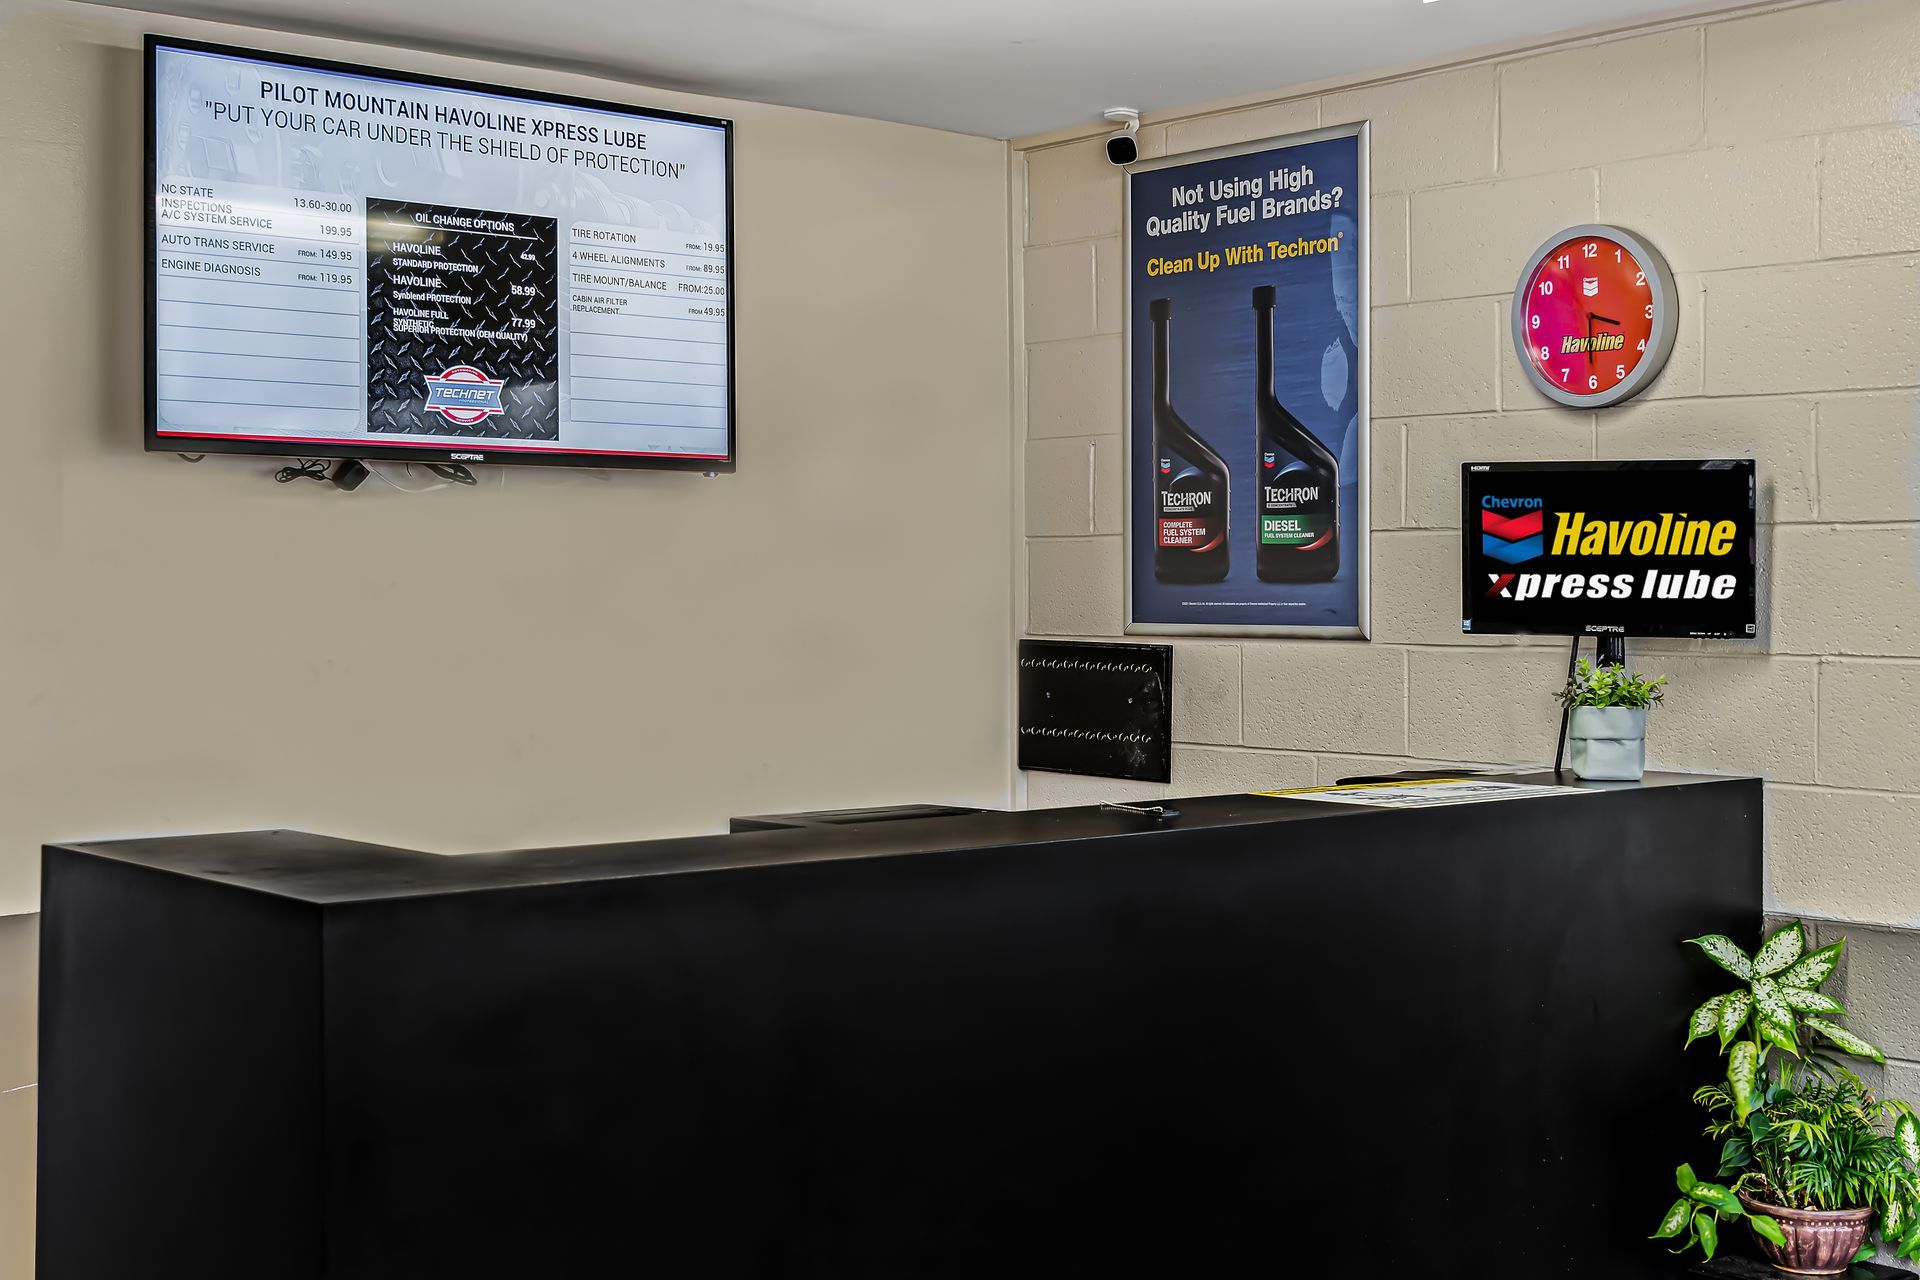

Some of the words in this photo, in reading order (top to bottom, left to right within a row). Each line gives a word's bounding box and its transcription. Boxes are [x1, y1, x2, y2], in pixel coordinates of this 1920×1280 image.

[260, 80, 319, 106] PILOT
[325, 90, 429, 121] MOUNTAIN
[435, 105, 527, 133] HAVOLINE
[531, 119, 599, 143] XPRESS
[604, 129, 647, 150] LUBE
[205, 101, 255, 124] "PUT
[261, 108, 316, 132] YOUR
[322, 117, 361, 139] CAR
[367, 123, 432, 147] UNDER
[437, 132, 473, 152] THE
[479, 137, 541, 161] SHIELD
[547, 146, 569, 164] OF
[574, 150, 686, 179] PROTECTION"
[161, 184, 177, 194] NC
[179, 185, 214, 198] STATE
[1172, 184, 1204, 207] Not
[1209, 176, 1263, 201] Using
[1269, 165, 1314, 193] High
[161, 198, 233, 214] INSPECTIONS
[294, 198, 352, 213] 13.60-30.00
[1146, 209, 1210, 237] Quality
[1216, 200, 1255, 226] Fuel
[1262, 186, 1343, 219] Brands?
[161, 209, 181, 220] A/C
[183, 211, 227, 224] SYSTEM
[230, 216, 272, 229] SERVICE
[415, 213, 431, 224] OIL
[433, 214, 472, 228] CHANGE
[473, 218, 515, 232] OPTIONS
[319, 225, 352, 237] 199.95
[572, 228, 591, 239] TIRE
[593, 231, 636, 244] ROTATION
[161, 234, 191, 246] AUTO
[194, 236, 230, 249] TRANS
[232, 240, 275, 254] SERVICE
[392, 242, 441, 256] HAVOLINE
[685, 243, 701, 251] FROM:
[703, 242, 725, 253] 19.95
[1582, 243, 1598, 258] 12
[298, 250, 317, 258] FROM:
[319, 249, 352, 261] 149.95
[572, 251, 578, 260] 4
[579, 252, 609, 263] WHEEL
[610, 256, 666, 269] ALIGNMENTS
[1146, 257, 1193, 277] Clean
[1197, 251, 1220, 273] Up
[1225, 244, 1264, 266] With
[1557, 255, 1570, 269] 11
[1614, 249, 1621, 263] 1
[161, 258, 202, 272] ENGINE
[204, 262, 261, 276] DIAGNOSIS
[392, 258, 433, 269] STANDARD
[433, 261, 479, 273] PROTECTION
[703, 264, 725, 274] 89.95
[298, 273, 317, 282] FROM:
[319, 273, 352, 285] 119.95
[392, 275, 442, 288] HAVOLINE
[572, 273, 591, 283] TIRE
[593, 275, 667, 291] MOUNT/BALANCE
[1635, 271, 1645, 286] 2
[511, 285, 536, 296] 58.99
[1538, 281, 1553, 295] 10
[392, 291, 425, 302] Synblend
[426, 293, 472, 305] PROTECTION
[572, 295, 593, 303] CABIN
[593, 296, 605, 304] AIR
[606, 297, 628, 306] FILTER
[393, 307, 430, 318] HAVOLINE
[431, 310, 449, 320] FULL
[572, 305, 619, 315] REPLACEMENT
[703, 307, 725, 317] 49.95
[1645, 304, 1653, 319] 3
[393, 318, 434, 328] SYNTHETIC
[511, 318, 536, 328] 77.99
[1531, 315, 1541, 329] 9
[393, 324, 429, 334] SUPERIOR
[430, 326, 476, 338] PROTECTION
[476, 330, 494, 340] (OEM
[495, 331, 528, 342] QUALITY)
[1560, 333, 1626, 354] Havoline
[1636, 339, 1646, 353] 4
[1541, 346, 1550, 360] 8
[1561, 368, 1570, 382] 7
[1615, 365, 1626, 379] 5
[1588, 375, 1598, 389] 6
[451, 453, 484, 461] SCEPTRE
[1161, 490, 1212, 508] TECHRON
[1264, 486, 1319, 504] TECHRON
[1481, 494, 1543, 509] Chevron
[1163, 528, 1179, 536] FUEL
[1179, 528, 1206, 536] SYSTEM
[1264, 520, 1301, 531] DIESEL
[1163, 536, 1193, 544] CLEANER
[1551, 512, 1737, 556] Havoline
[1641, 569, 1737, 600] lube
[1585, 625, 1625, 633] SCEPTRE
